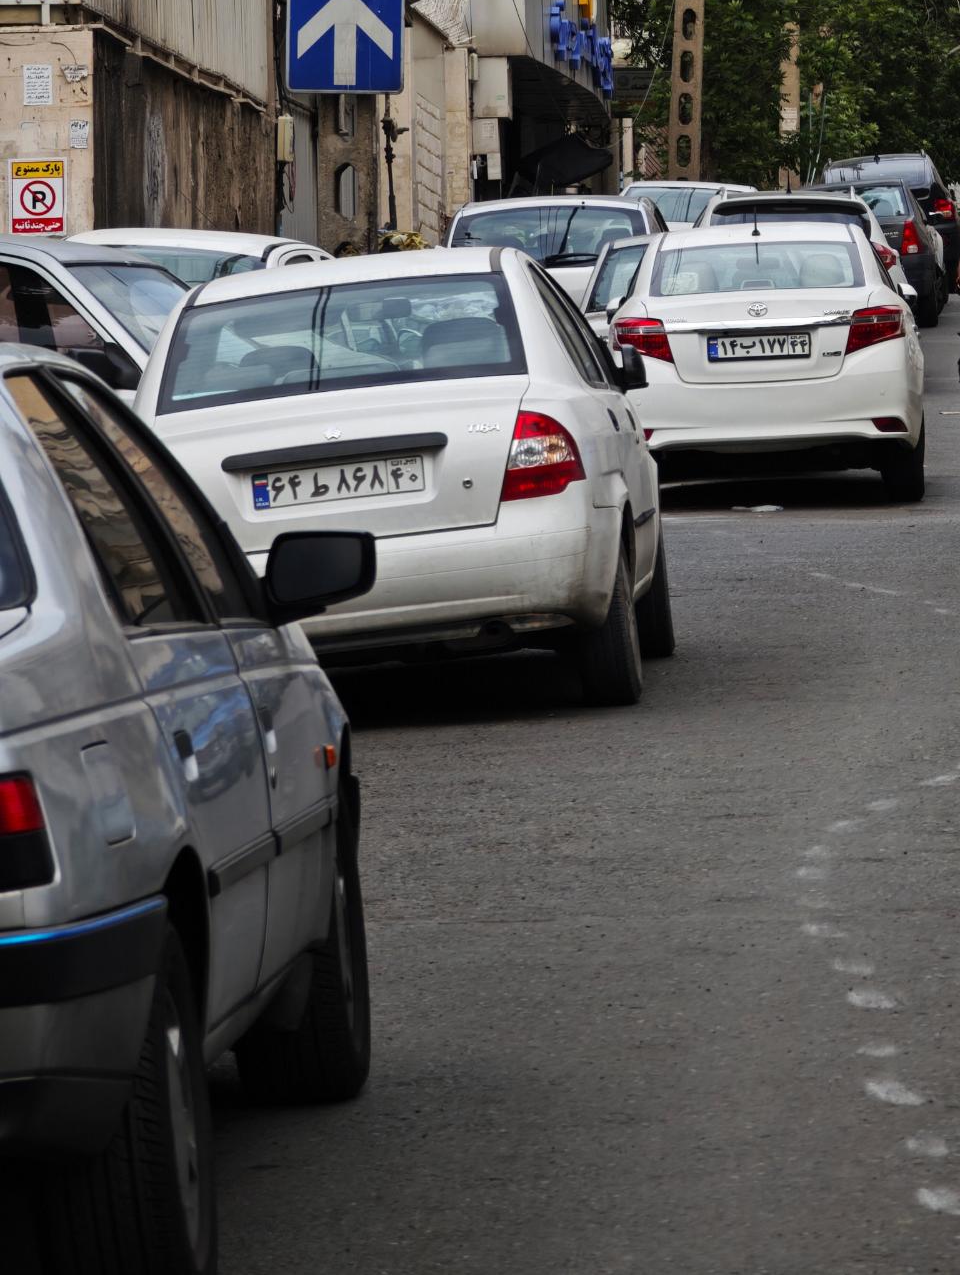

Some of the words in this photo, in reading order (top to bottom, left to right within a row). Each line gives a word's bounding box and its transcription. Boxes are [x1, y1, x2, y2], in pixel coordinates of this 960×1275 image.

[15, 165, 40, 176] ممنوع
[42, 163, 61, 175] پارک
[32, 190, 46, 209] P
[15, 220, 31, 231] ثانیه
[31, 222, 45, 232] چند
[45, 221, 61, 231] حتی
[467, 421, 501, 433] TIBA
